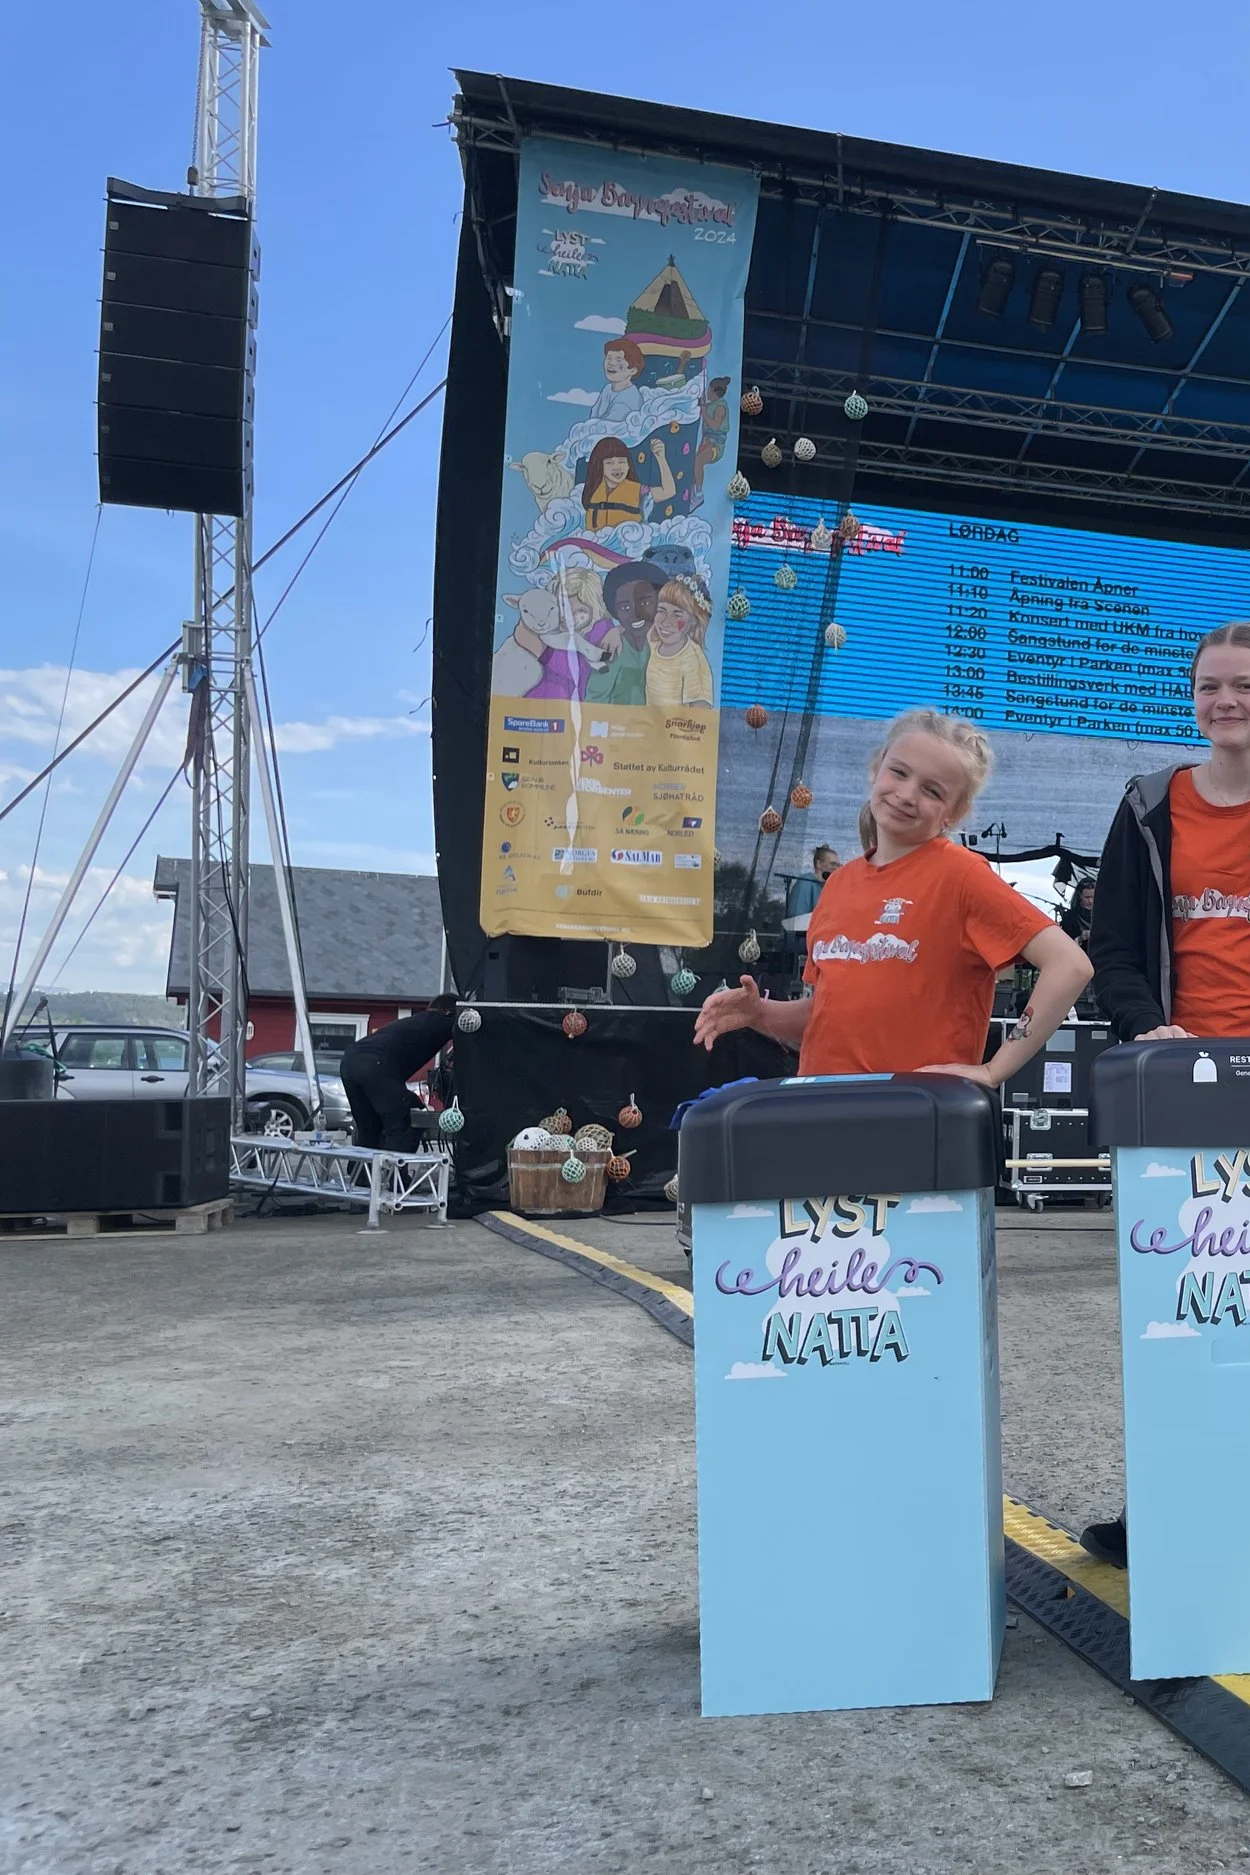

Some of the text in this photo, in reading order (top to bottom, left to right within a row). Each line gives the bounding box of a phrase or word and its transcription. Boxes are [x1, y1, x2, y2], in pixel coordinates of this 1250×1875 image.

[538, 172, 597, 214] Senja
[554, 229, 589, 247] LYST
[694, 228, 737, 245] 2024
[949, 521, 1020, 543] LØRDAG
[947, 563, 1139, 597] 11:00 Festivalen Åpner
[947, 582, 1150, 616] 11:10 Åpning fra Scenen
[947, 603, 988, 619] 11:20
[1008, 610, 1069, 628] Konsert
[1075, 619, 1109, 633] med
[1113, 620, 1150, 637] UKM
[1155, 625, 1175, 639] fra
[945, 624, 1194, 660] 12:00 Sangstund for de minste
[945, 643, 986, 659] 12:30
[1007, 651, 1067, 669] Eventyr
[1078, 656, 1132, 672] Parken
[1137, 662, 1174, 677] (max
[945, 664, 985, 680] 13:00
[1007, 670, 1119, 693] Bestillingsverk
[1123, 683, 1157, 696] med
[944, 682, 1192, 718] 13:45 Sangstund for de minste
[507, 717, 549, 728] SpareBank
[552, 722, 558, 731] 1
[1005, 710, 1065, 729] Eventyr
[1076, 716, 1131, 733] Parken
[1135, 720, 1171, 737] (max
[1175, 725, 1193, 738] 50
[613, 761, 705, 775] Støttet av Kulturrådet
[666, 830, 695, 838] NORLED
[779, 1194, 902, 1243] LYST
[761, 1306, 910, 1367] NATTA
